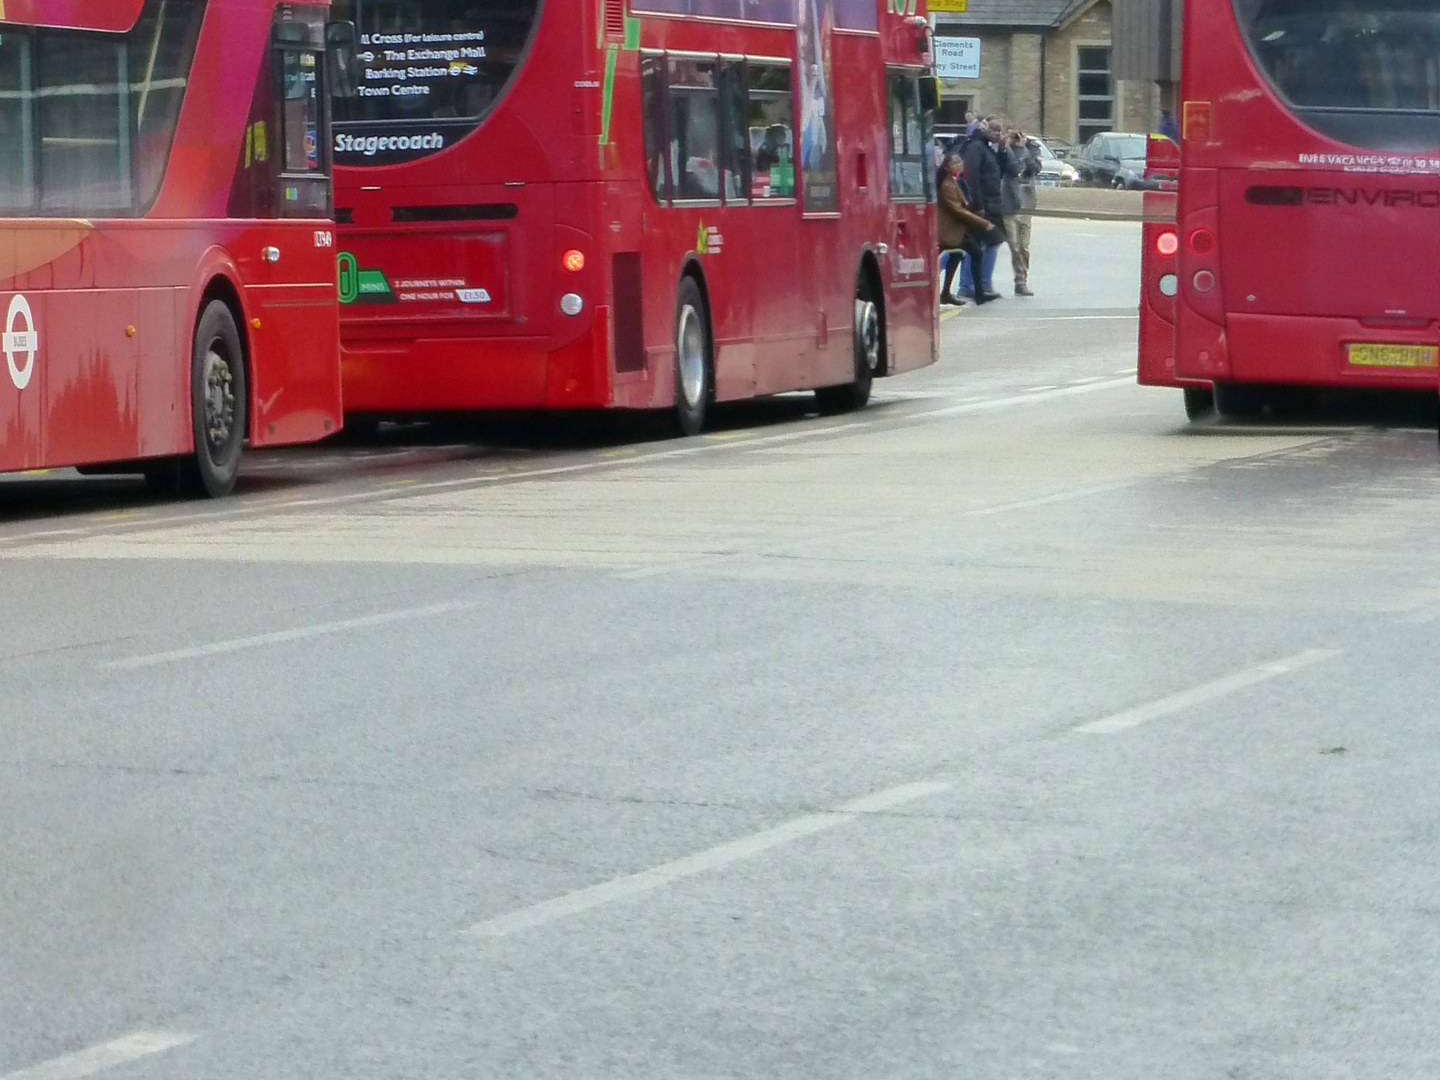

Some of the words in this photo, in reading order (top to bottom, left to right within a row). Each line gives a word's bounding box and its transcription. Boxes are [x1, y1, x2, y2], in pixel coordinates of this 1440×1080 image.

[371, 33, 403, 44] Cross
[384, 50, 406, 61] The
[407, 48, 459, 61] Exchange
[460, 47, 486, 58] Mall
[941, 49, 964, 57] Road
[937, 63, 947, 71] ey
[950, 62, 977, 71] Street
[365, 68, 406, 80] Barking
[407, 66, 448, 78] Station
[357, 85, 390, 97] Town
[391, 84, 430, 95] Centre
[334, 132, 444, 156] Stagecoach
[360, 283, 385, 292] MINS
